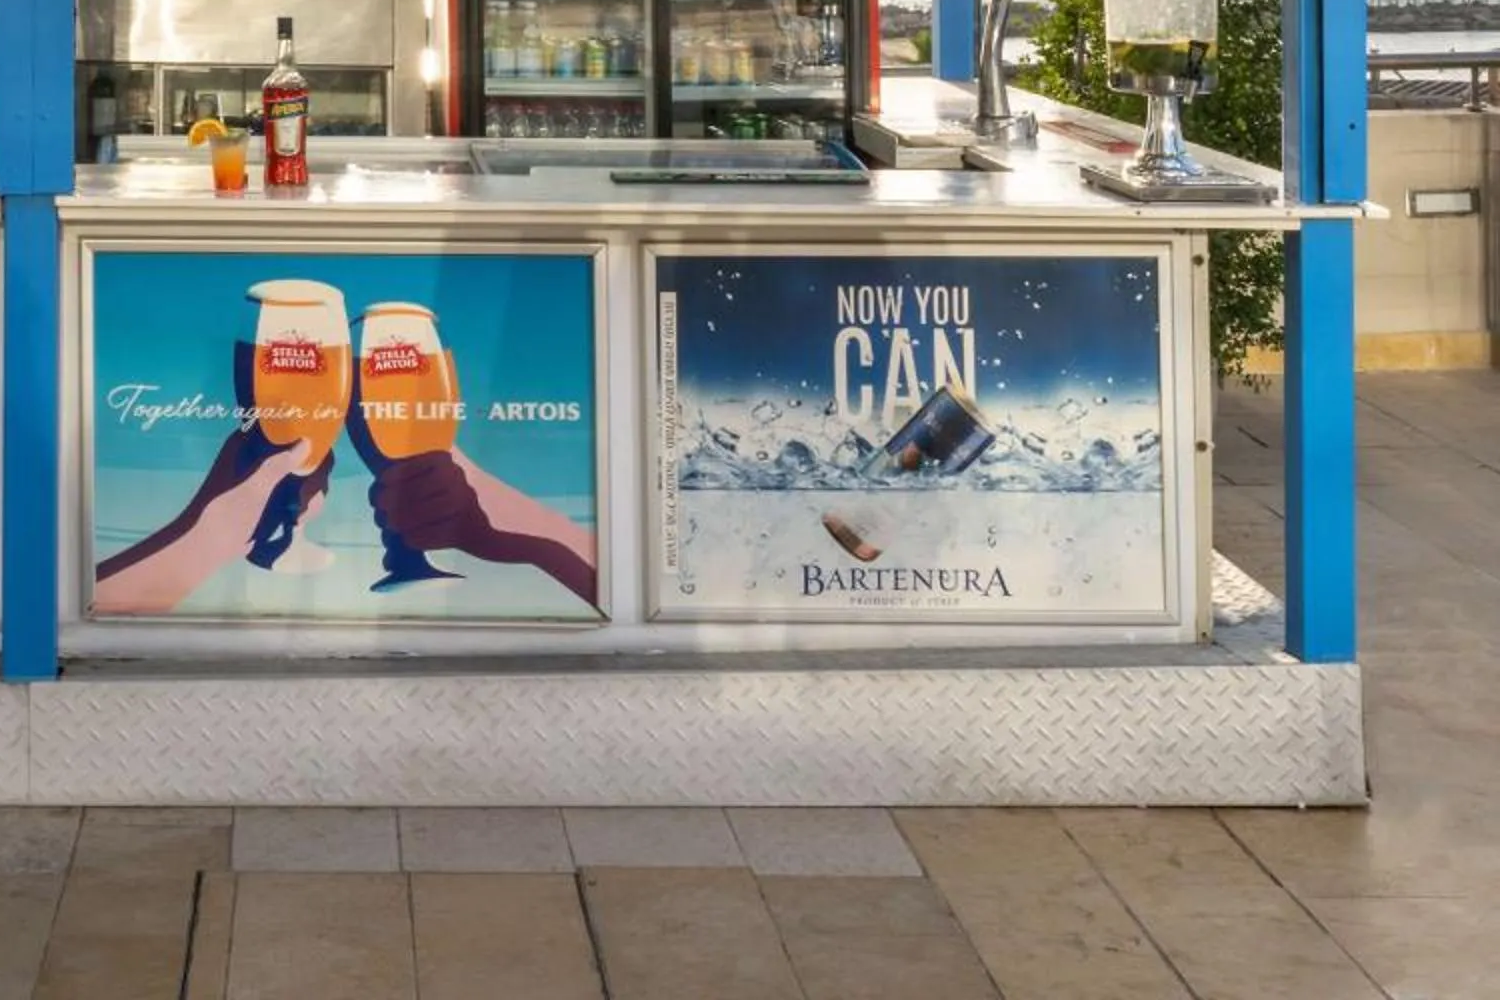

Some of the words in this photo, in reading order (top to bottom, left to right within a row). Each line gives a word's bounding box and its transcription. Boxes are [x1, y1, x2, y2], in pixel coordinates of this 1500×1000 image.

[837, 285, 904, 325] NOW
[914, 285, 970, 325] YOU
[271, 347, 316, 358] STELLA
[373, 349, 417, 361] STELLA
[271, 357, 317, 369] ARTOIS
[375, 358, 419, 371] ARTOIS
[834, 326, 976, 428] CAN
[106, 383, 227, 431] Together
[232, 402, 307, 431] again
[312, 402, 342, 420] in
[359, 401, 408, 421] THE
[415, 401, 467, 421] LIFE
[488, 401, 581, 421] ARTOIS
